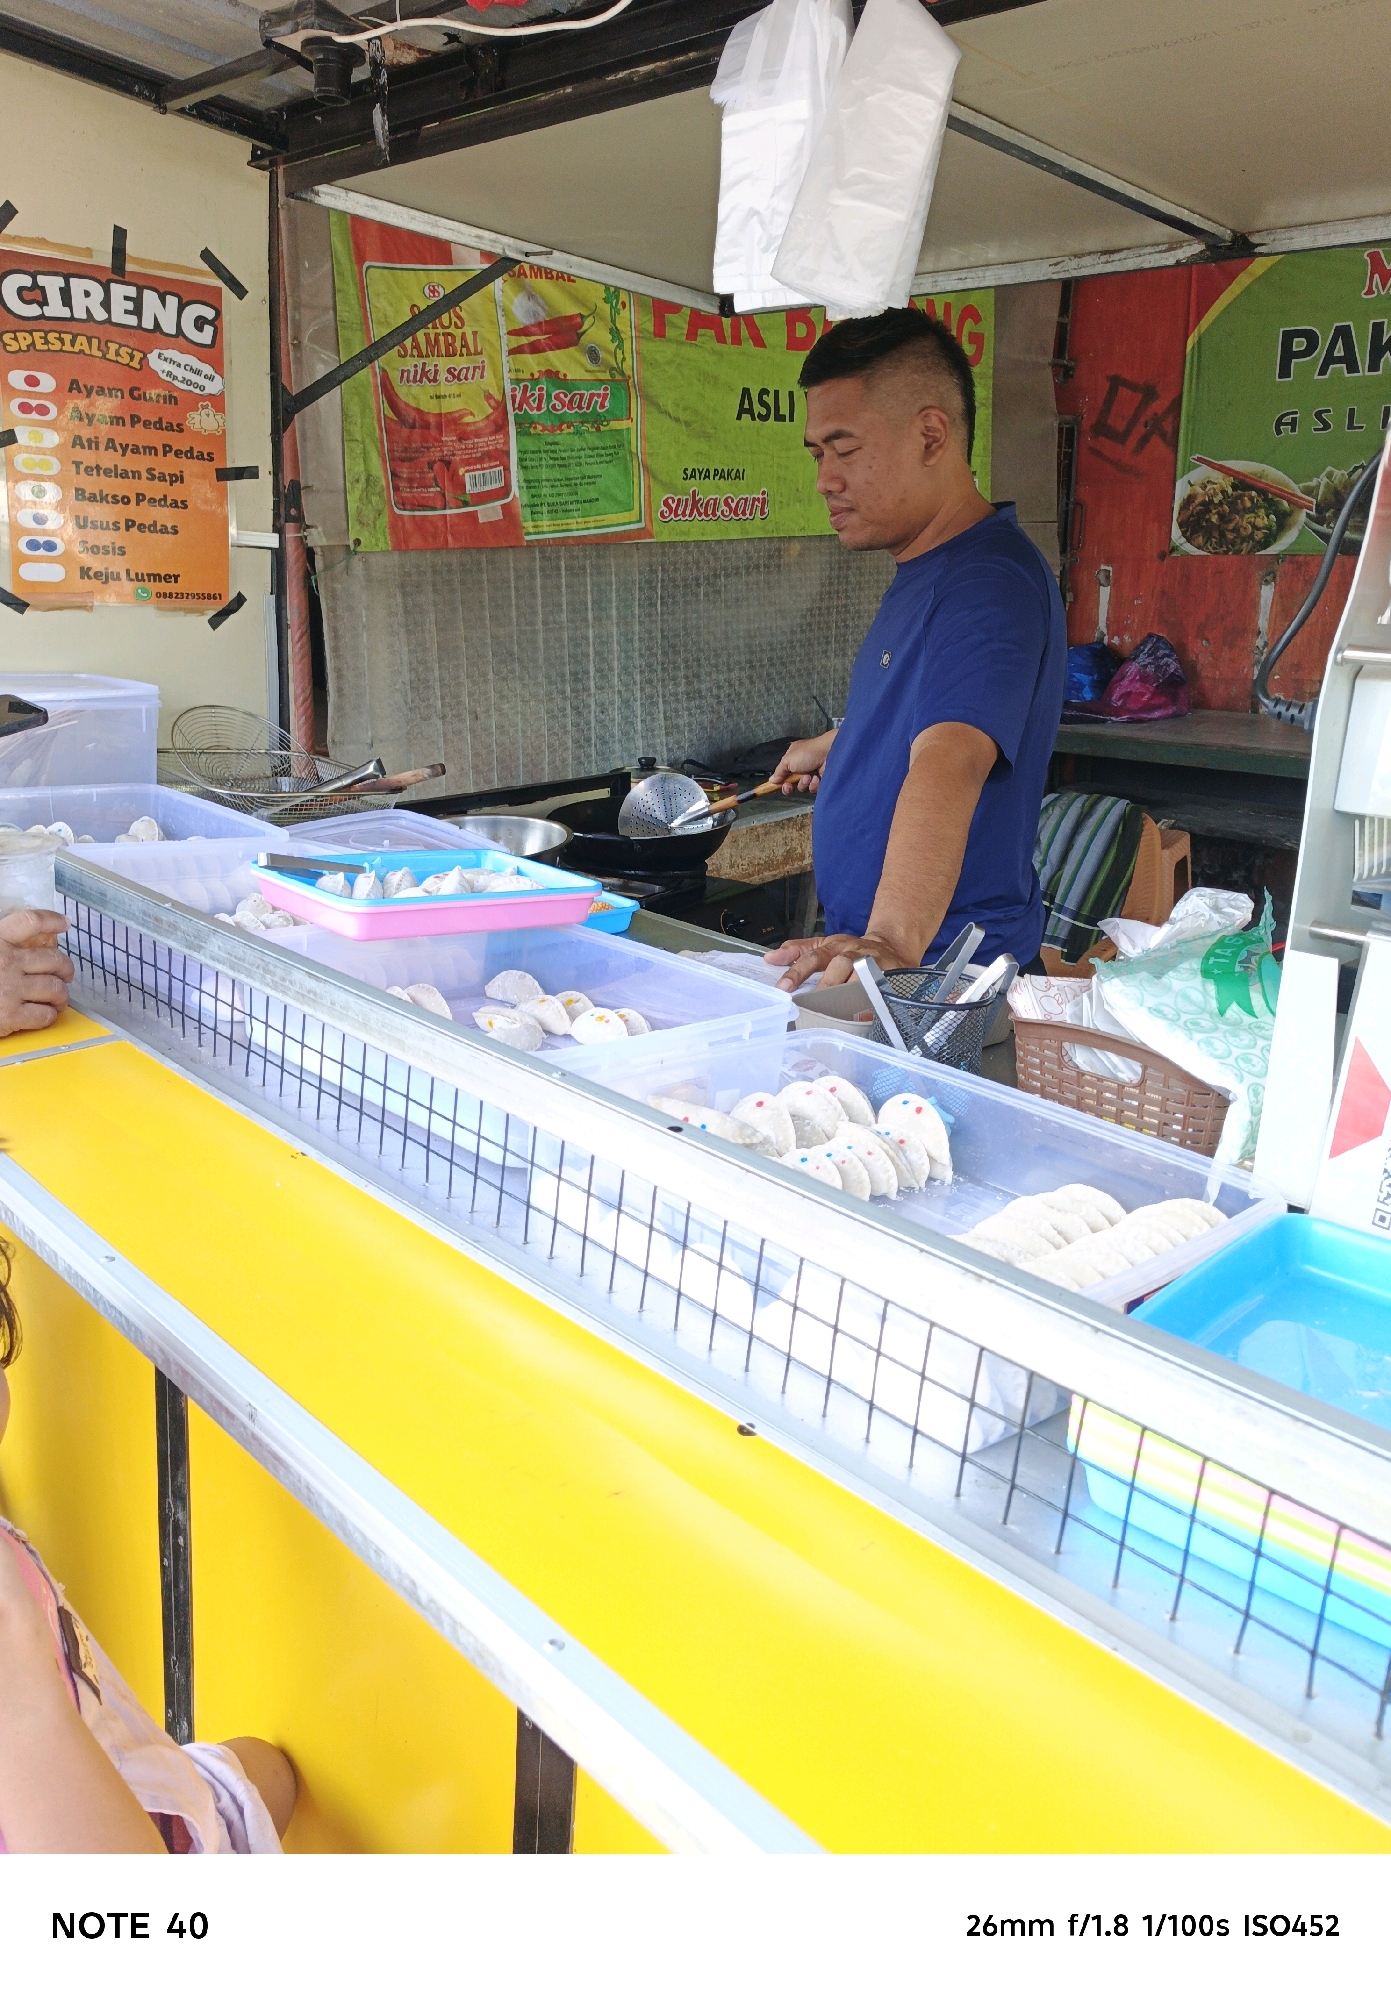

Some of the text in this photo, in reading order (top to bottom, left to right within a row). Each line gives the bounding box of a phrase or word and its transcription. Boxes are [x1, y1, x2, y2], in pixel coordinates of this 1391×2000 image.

[0, 270, 218, 347] CIRENG
[2, 331, 144, 370] SPESIAL ISI
[397, 331, 484, 358] SAMBAL
[157, 351, 182, 369] Extra
[183, 363, 204, 378] Chili
[398, 360, 487, 385] niki sari
[68, 378, 179, 406] Ayam Gurih
[550, 384, 610, 414] sari
[736, 387, 795, 422] ASLI
[70, 407, 185, 434] Ayam Pedas
[71, 434, 215, 463] Ati Ayam Pedas
[72, 460, 185, 487] Tetelan Sapi
[682, 467, 746, 481] SAYA PAKAI
[74, 487, 189, 510] Bakso Pedas
[75, 514, 180, 536] Usus Pedas
[77, 540, 127, 557] Sosis
[79, 565, 181, 585] Keju Lumer
